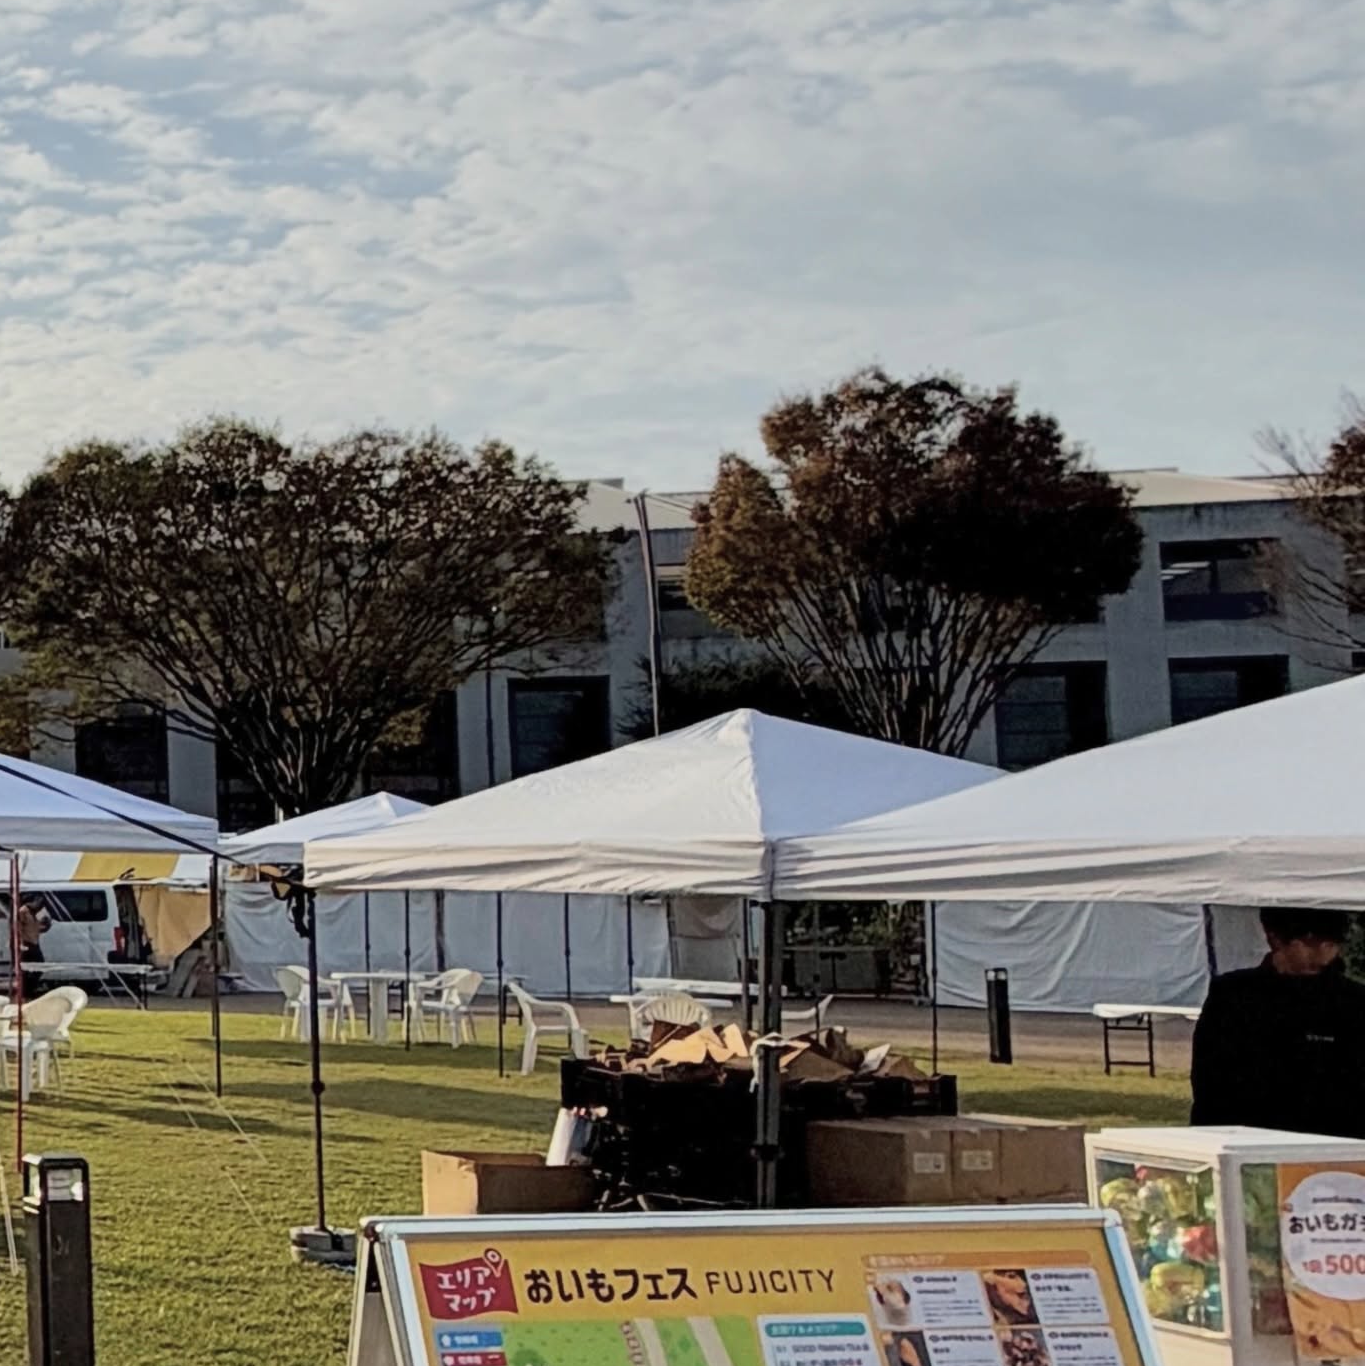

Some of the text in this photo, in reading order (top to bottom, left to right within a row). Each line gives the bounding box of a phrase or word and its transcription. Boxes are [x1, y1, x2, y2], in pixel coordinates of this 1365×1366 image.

[436, 1265, 491, 1289] エリア
[524, 1267, 836, 1304] おいもフェス FUJICITY
[443, 1287, 497, 1314] マップ
